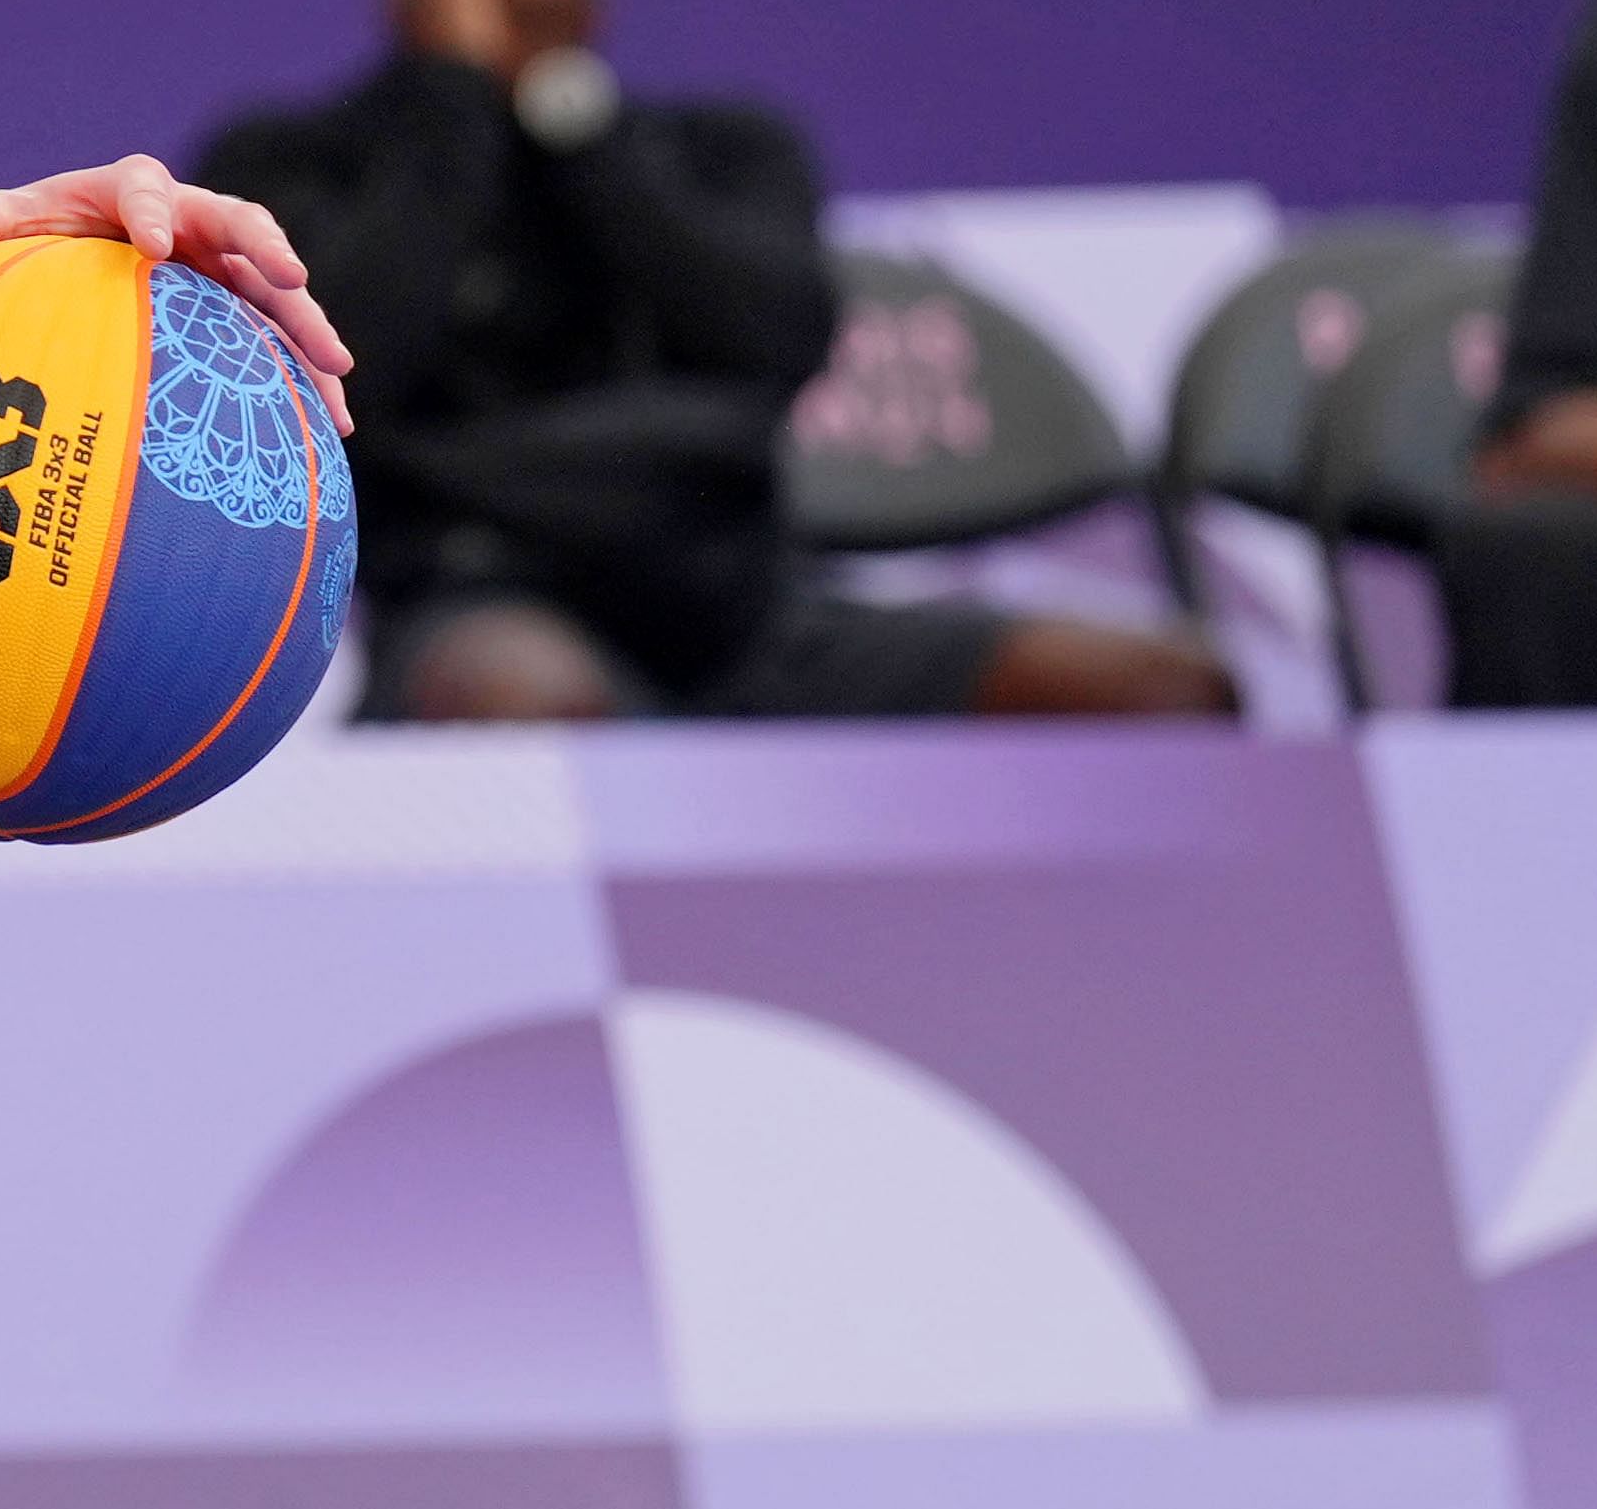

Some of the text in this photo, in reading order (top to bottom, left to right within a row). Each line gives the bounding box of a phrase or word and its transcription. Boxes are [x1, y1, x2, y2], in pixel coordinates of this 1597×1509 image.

[29, 434, 69, 549] FIBA 3x3
[49, 411, 103, 588] OFFICIAL BALL
